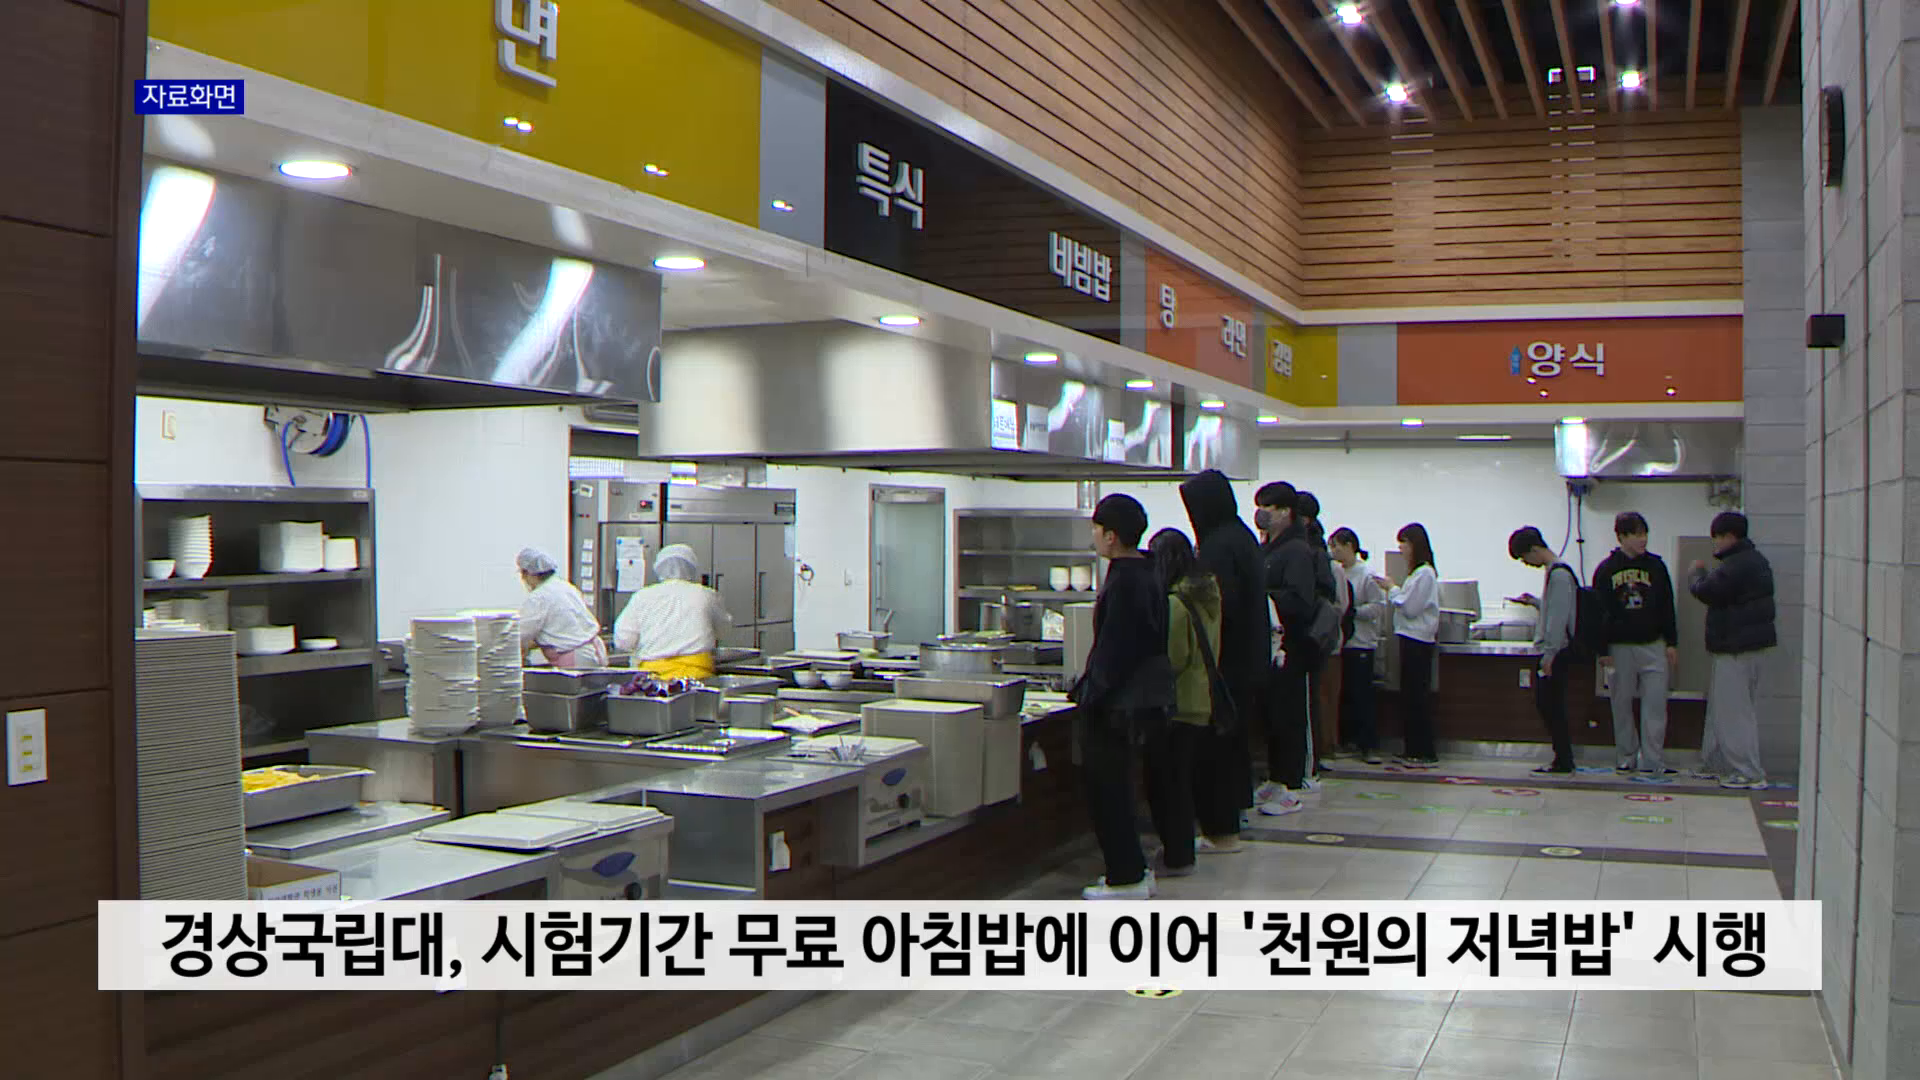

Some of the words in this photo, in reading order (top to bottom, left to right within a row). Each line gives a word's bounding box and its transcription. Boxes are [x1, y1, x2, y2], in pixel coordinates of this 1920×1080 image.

[856, 142, 924, 230] 특식
[1049, 231, 1112, 303] 비빔밥
[1160, 283, 1176, 330] 탕
[1221, 314, 1247, 360] 라면
[1527, 341, 1605, 377] 양식
